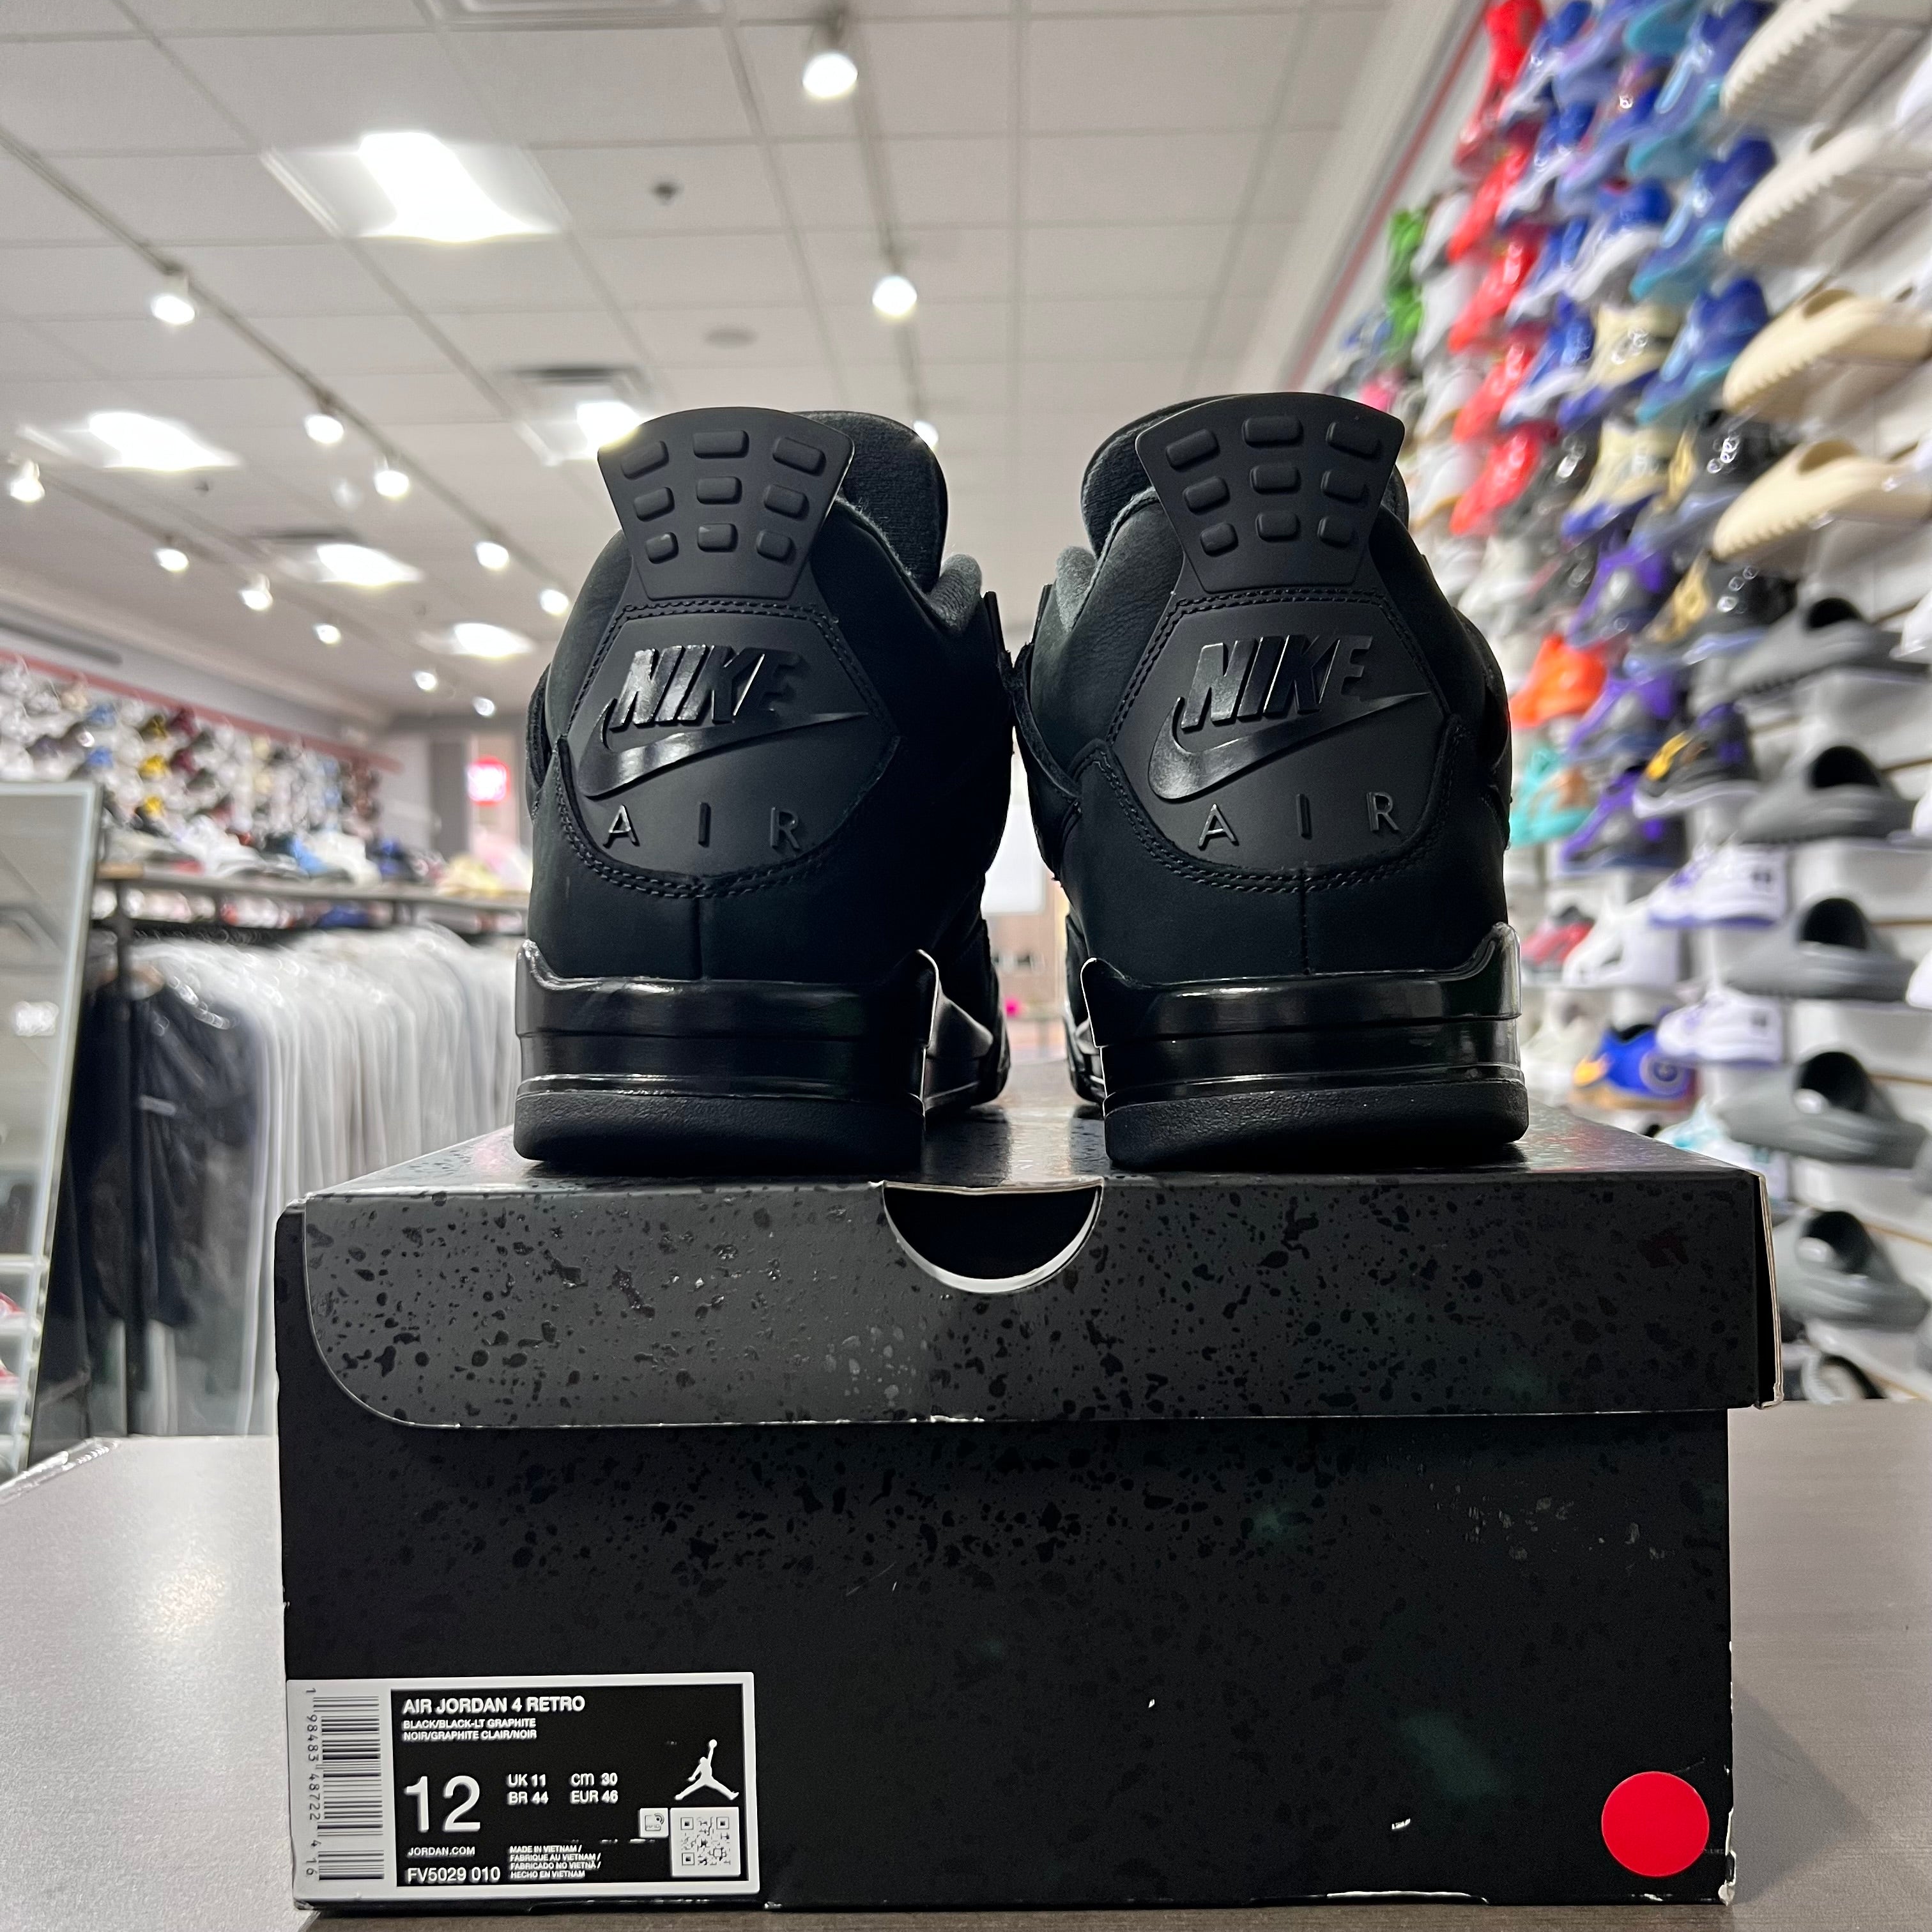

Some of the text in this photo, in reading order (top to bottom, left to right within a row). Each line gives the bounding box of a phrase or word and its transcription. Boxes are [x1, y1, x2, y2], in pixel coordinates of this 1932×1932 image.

[609, 644, 804, 729] NIKE
[1181, 634, 1372, 730] NIKE
[402, 1696, 585, 1714] AIR JORDAN 4 RETRO
[402, 1718, 537, 1730] BLACK/BLACK-LT GRAPHITE
[307, 1714, 319, 1761] 98483
[403, 1729, 537, 1742] NOIR/GRAPHITE CLAIR/NOIR
[507, 1774, 546, 1787] UK 11
[571, 1772, 618, 1786] cm 30
[309, 1773, 321, 1821] 48722
[405, 1775, 481, 1832] 12
[507, 1791, 549, 1805] BR 44
[571, 1790, 618, 1804] EUR 46
[408, 1846, 475, 1858] JORDAN.COM
[509, 1853, 549, 1862] FABRIQUE
[562, 1853, 596, 1861] VIETNAM
[509, 1862, 555, 1870] FABRICADO
[555, 1862, 568, 1870] NO
[406, 1866, 501, 1883] FV5029 010
[551, 1869, 586, 1878] VIETNAM
